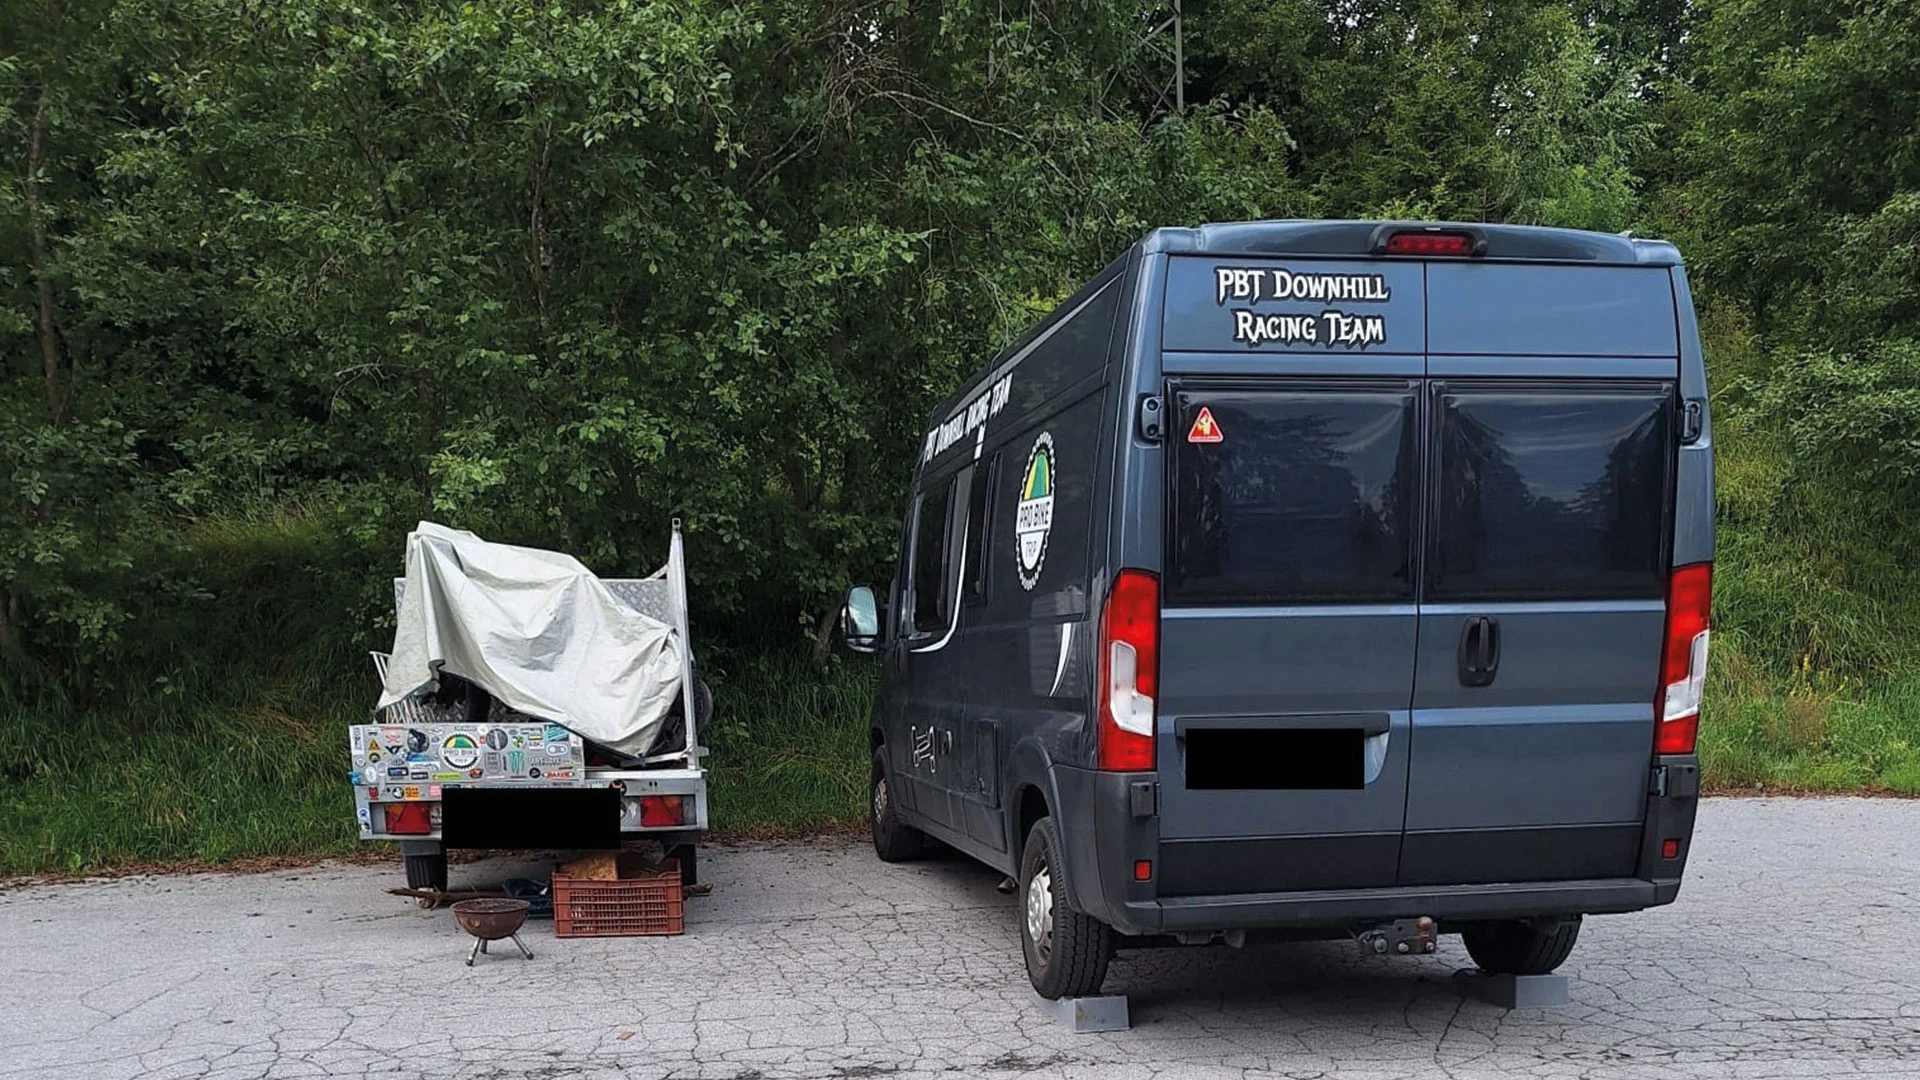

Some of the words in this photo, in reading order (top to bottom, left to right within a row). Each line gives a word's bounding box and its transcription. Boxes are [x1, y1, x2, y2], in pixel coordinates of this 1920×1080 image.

[1216, 268, 1266, 303] PBT
[1019, 504, 1033, 529] PRO
[1033, 501, 1051, 527] BIKE
